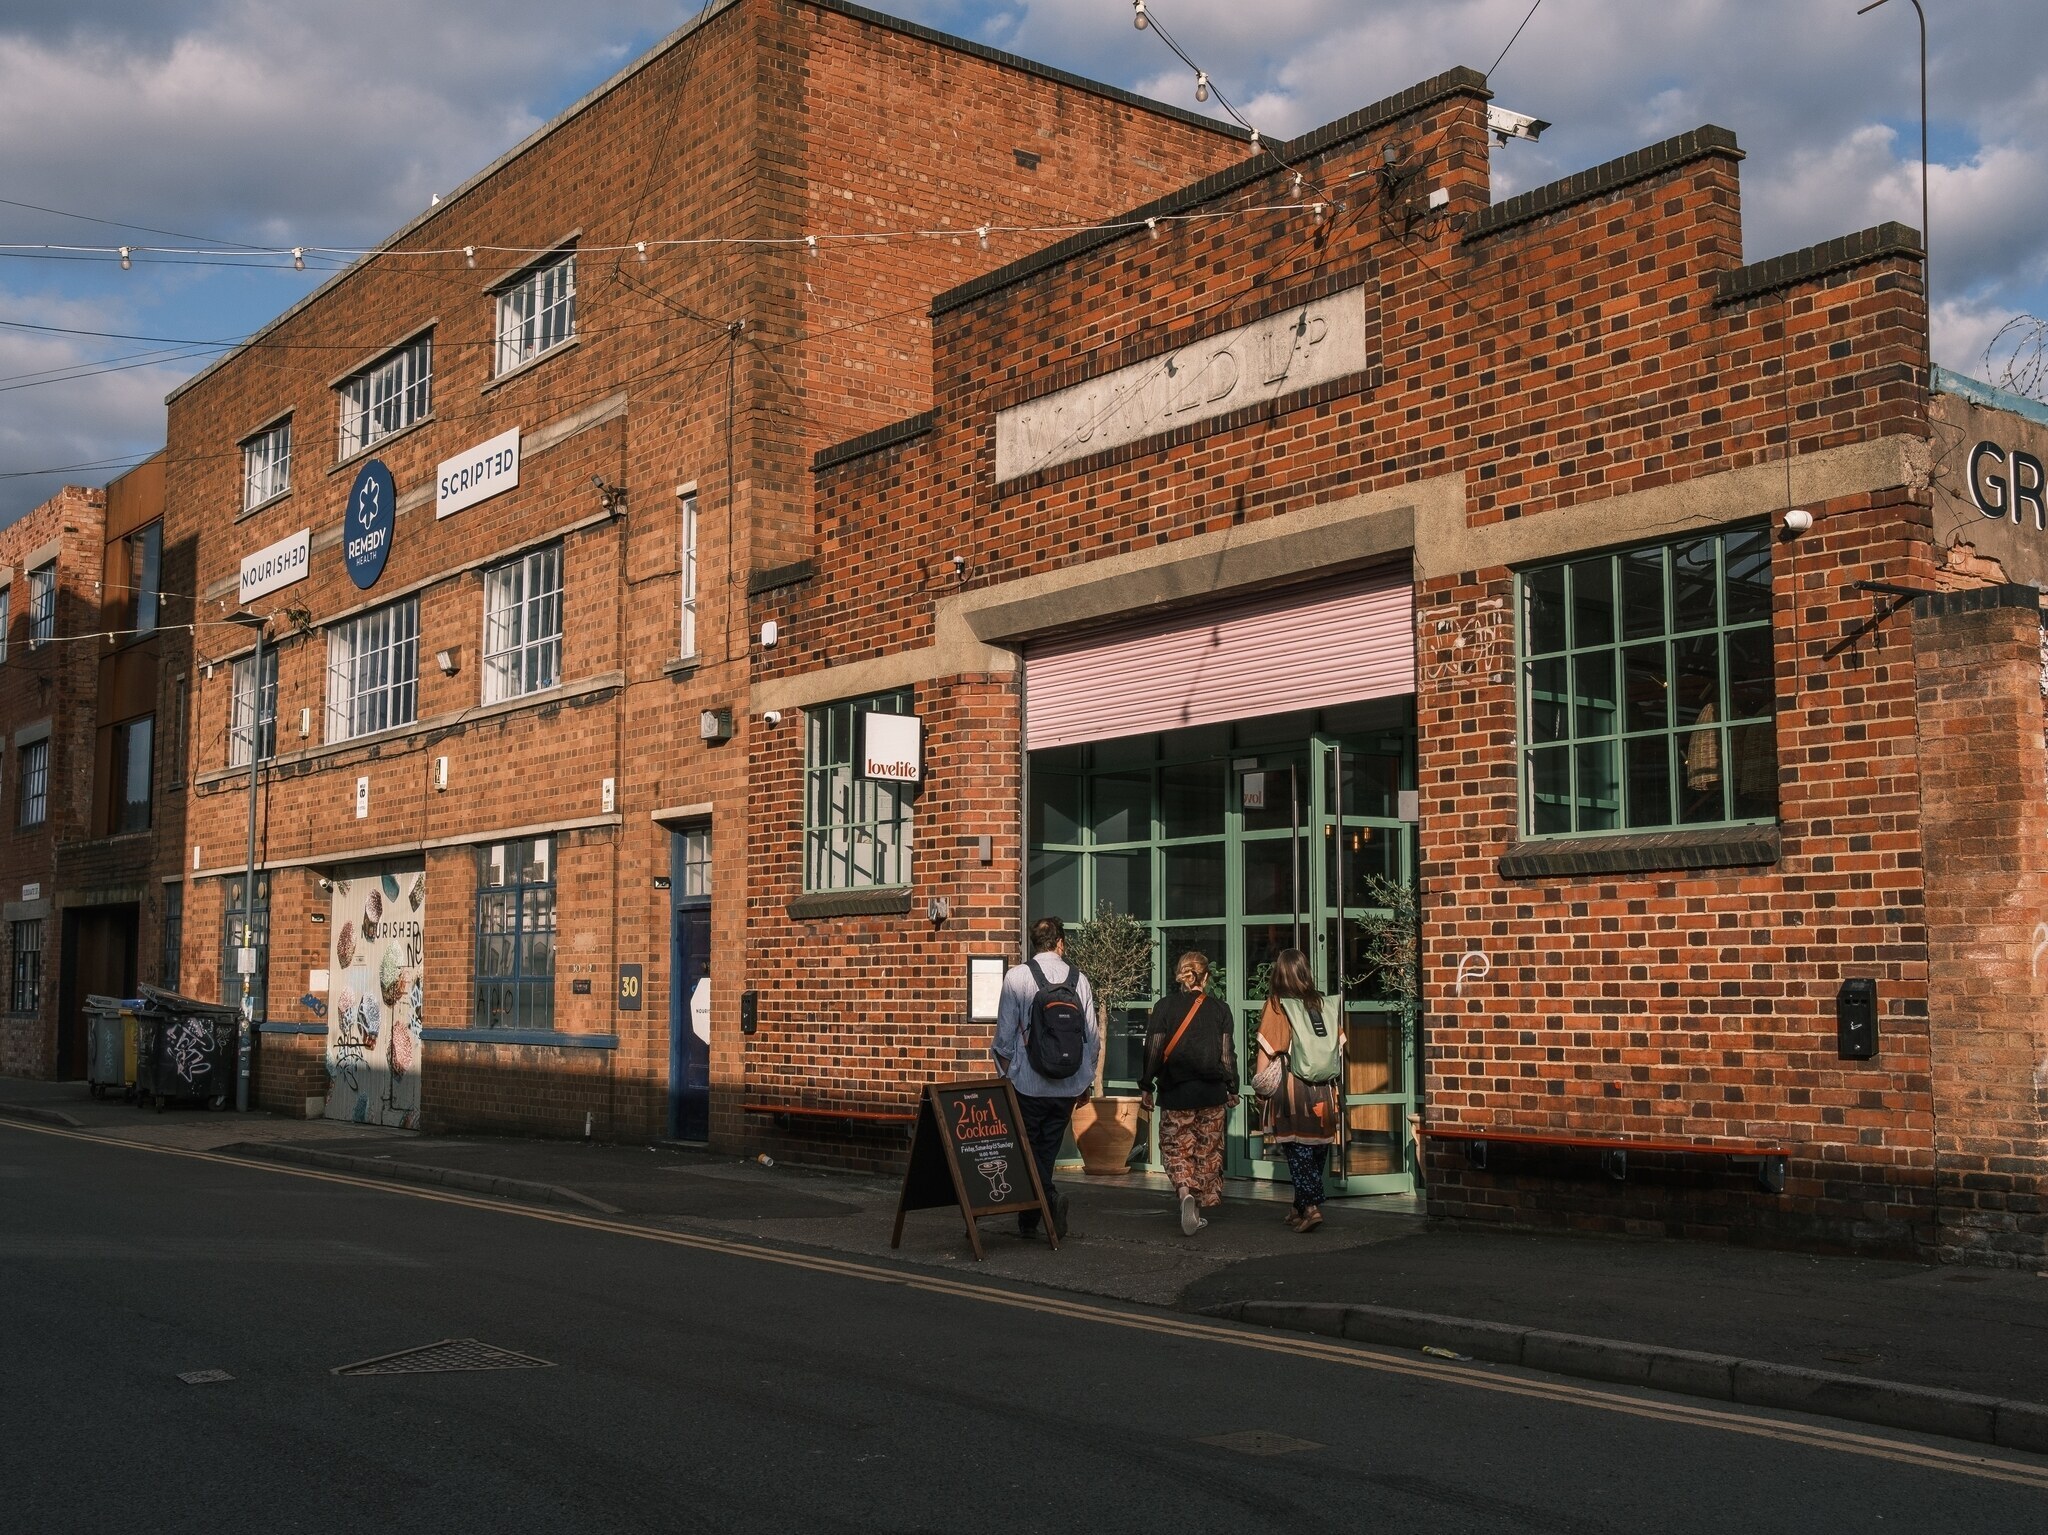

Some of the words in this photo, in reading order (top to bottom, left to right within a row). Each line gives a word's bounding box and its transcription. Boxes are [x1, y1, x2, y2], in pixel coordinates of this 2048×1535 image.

[1966, 440, 2048, 532] GR
[355, 551, 378, 567] HEALTH
[867, 758, 917, 779] lovelife
[621, 975, 639, 998] 30
[954, 1102, 970, 1124] 2
[971, 1105, 988, 1123] for
[987, 1098, 998, 1120] 1
[956, 1119, 1008, 1140] Cocktails
